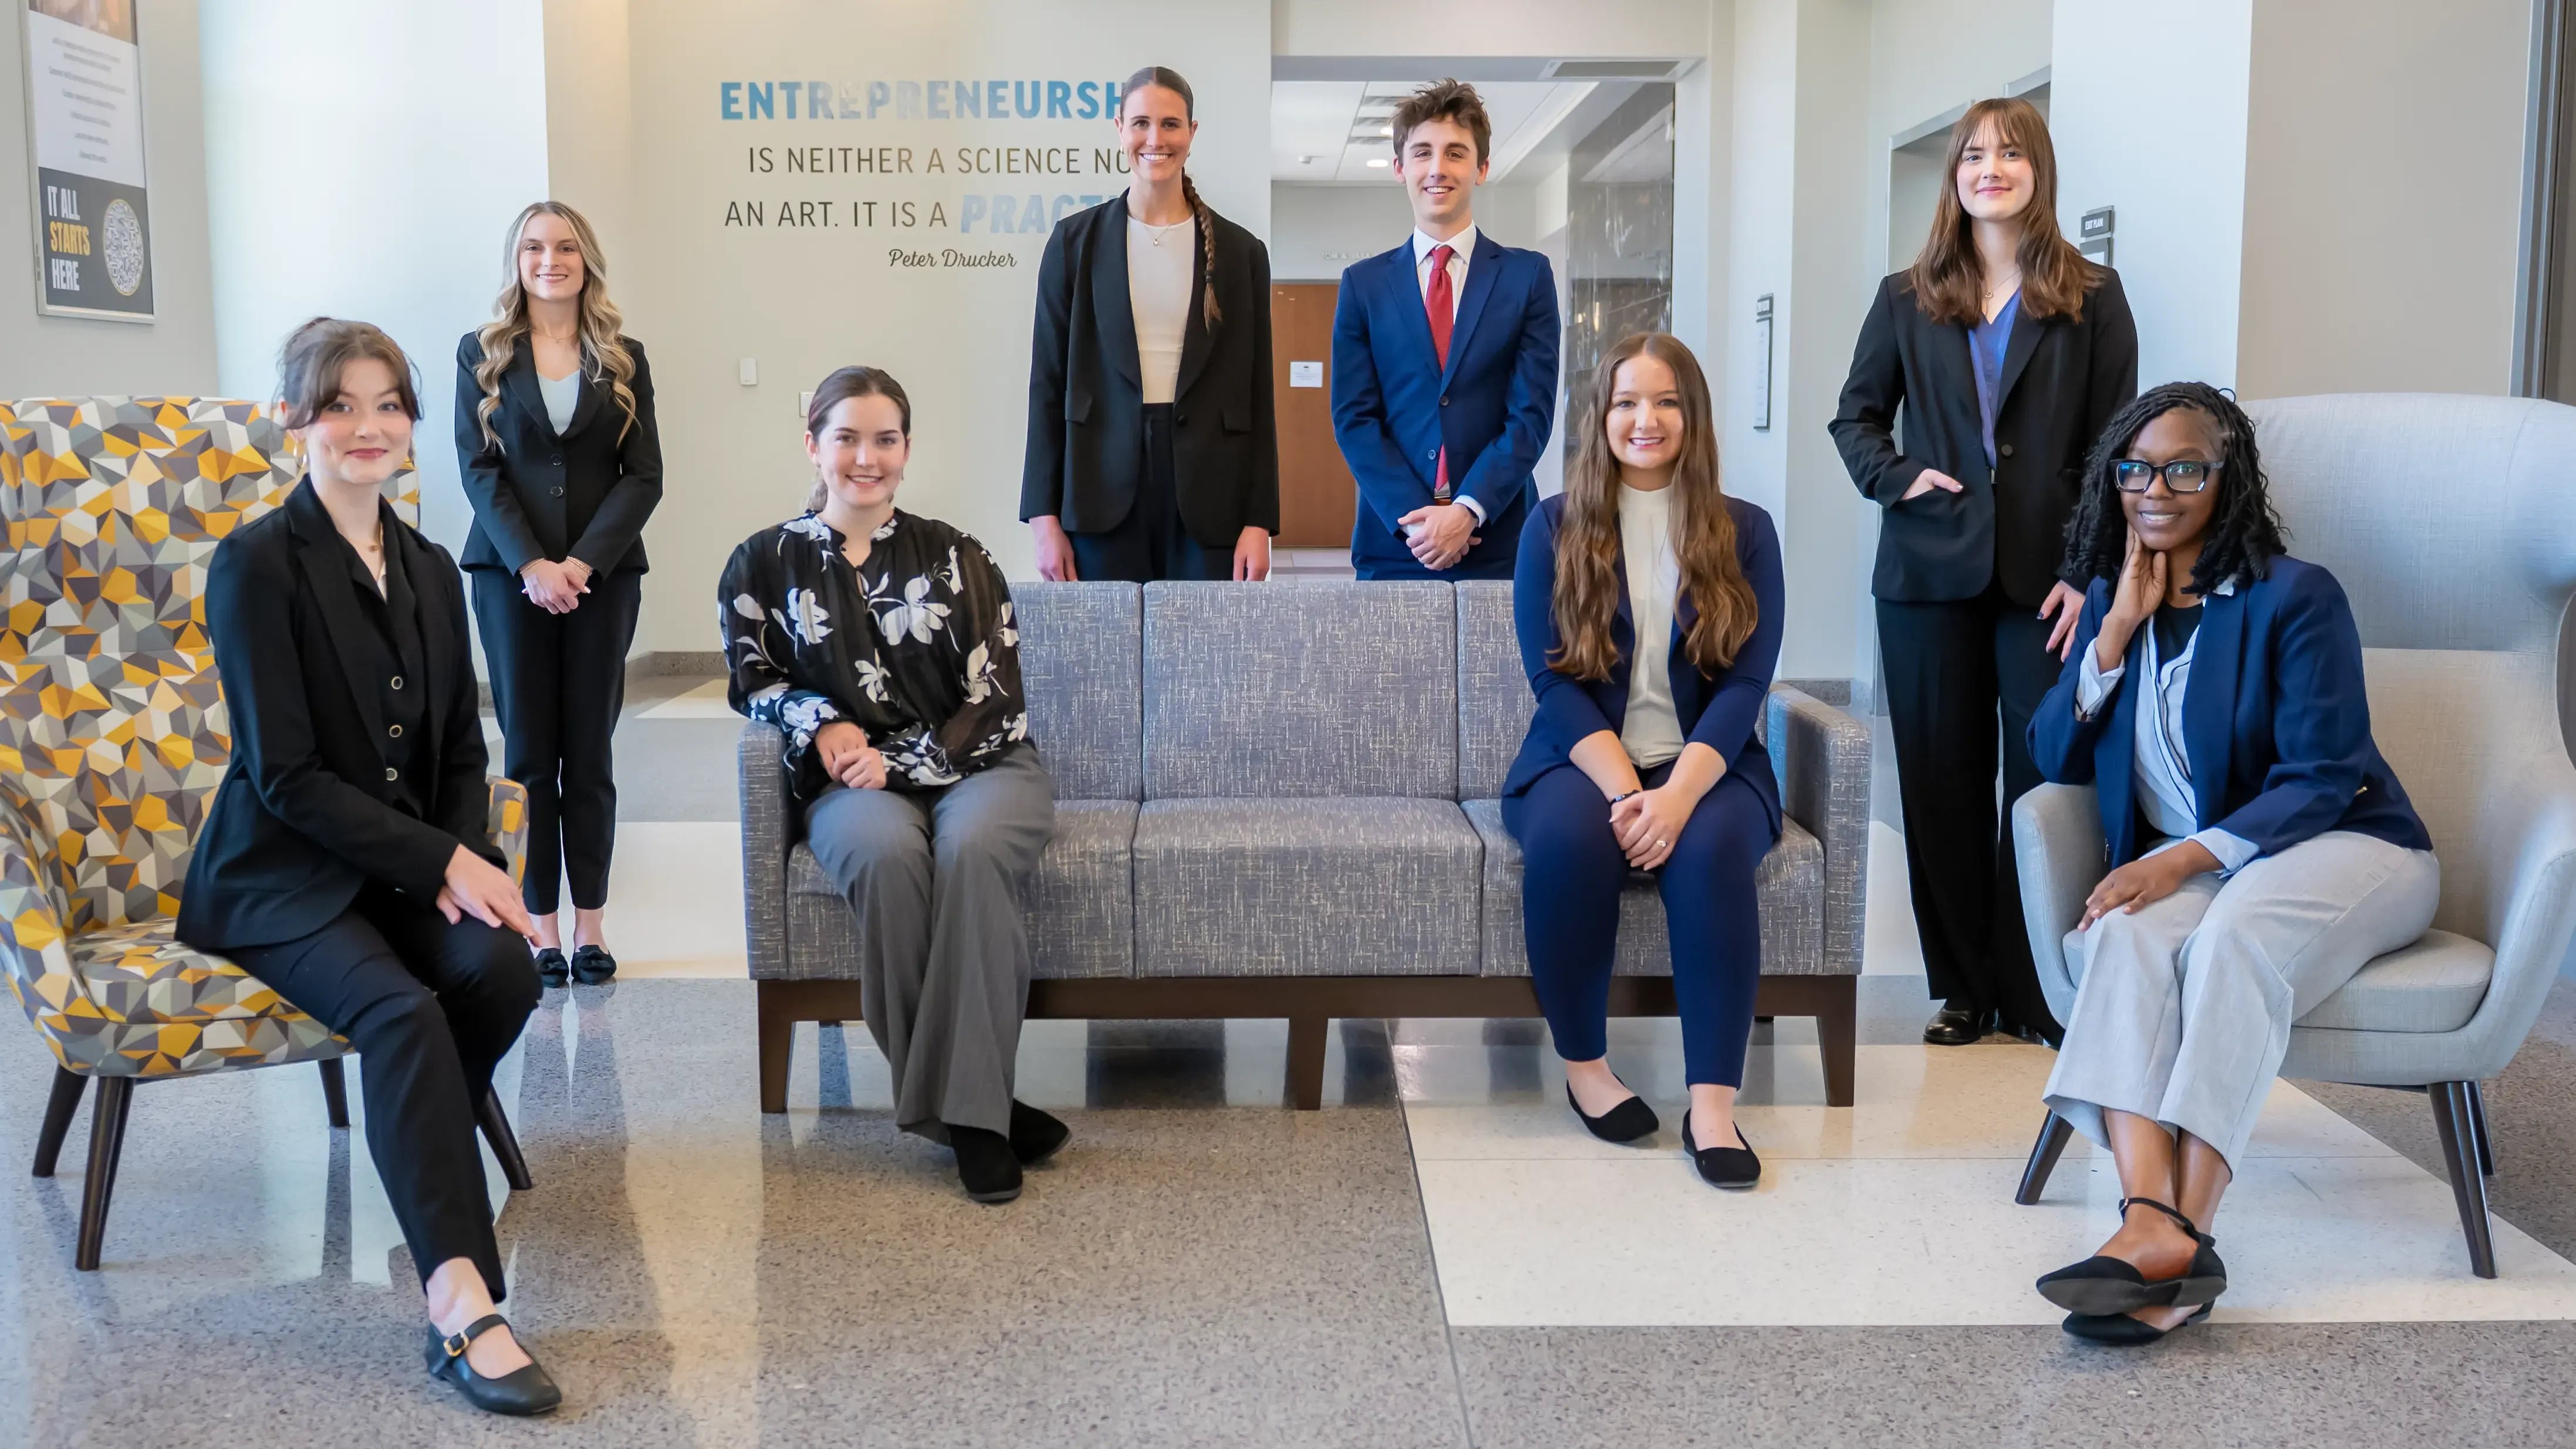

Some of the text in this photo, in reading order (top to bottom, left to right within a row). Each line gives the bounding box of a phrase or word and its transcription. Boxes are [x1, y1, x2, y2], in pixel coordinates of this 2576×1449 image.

[721, 80, 1122, 120] ENTREPRENEURSH
[749, 147, 1131, 174] IS NEITHER A SCIENCE NO
[48, 185, 81, 221] IT ALL
[725, 194, 1120, 234] AN ART. IT IS A PRAC
[50, 221, 91, 256] STARTS
[2093, 217, 2103, 228] PLAN
[52, 258, 80, 291] HERE
[889, 249, 1018, 268] Peter Drucker
